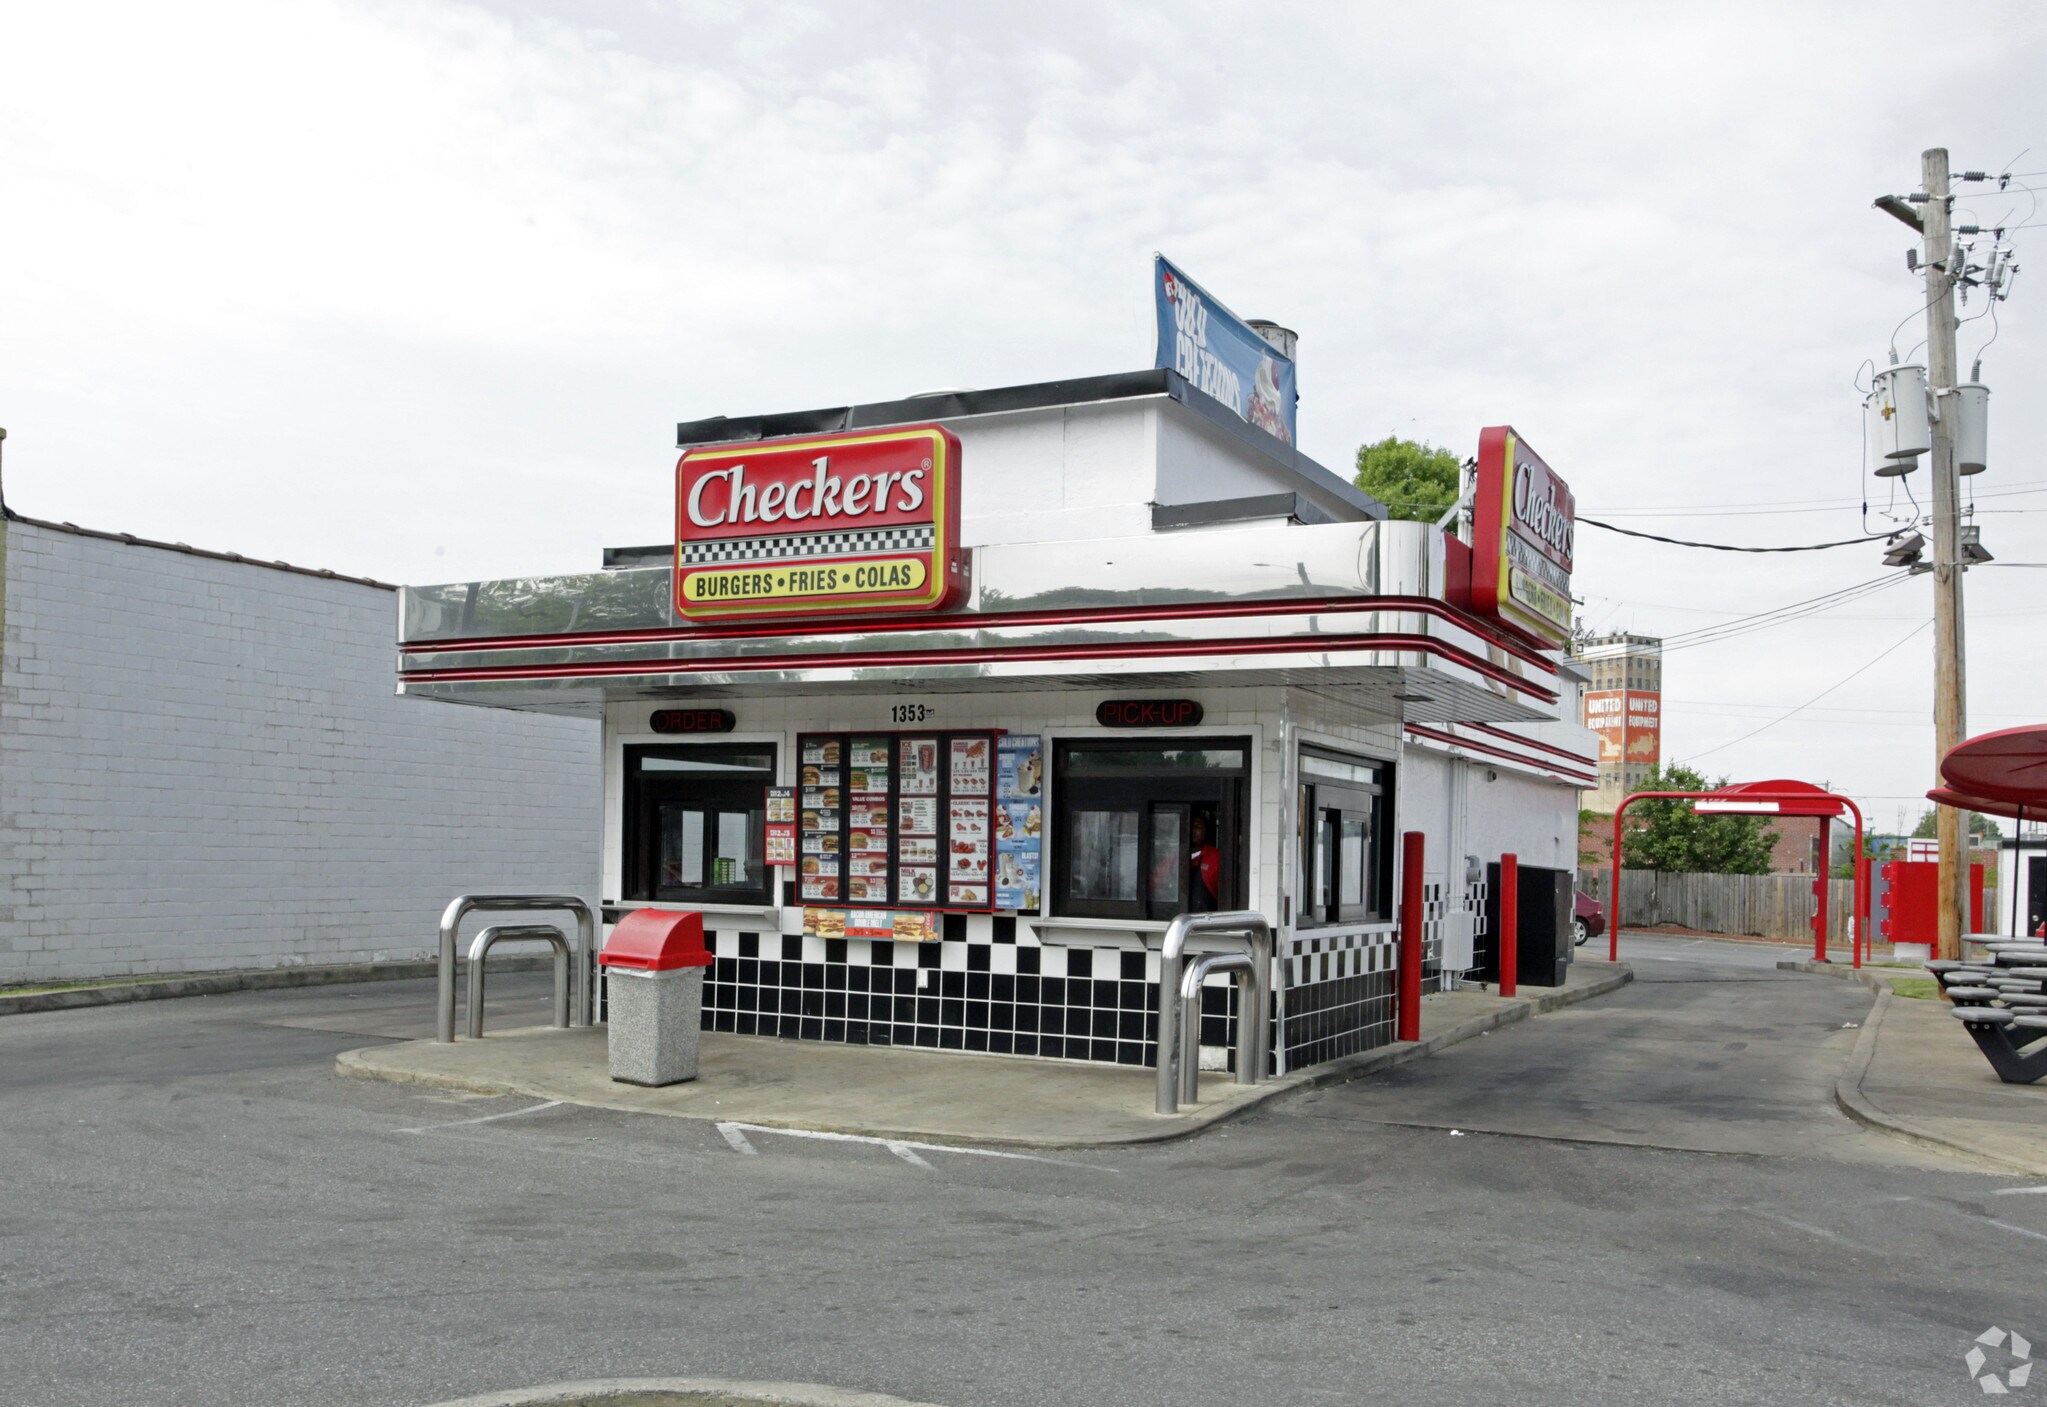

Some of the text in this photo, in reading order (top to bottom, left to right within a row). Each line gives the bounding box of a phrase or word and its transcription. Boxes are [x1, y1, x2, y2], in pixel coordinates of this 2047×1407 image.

[687, 456, 925, 527] Checkers
[1513, 462, 1574, 562] Checkers
[696, 564, 911, 597] BURGERS FRIES COLAS
[891, 704, 925, 723] 1353
[1104, 702, 1193, 724] PICK-UP
[1588, 697, 1621, 714] UNITED
[1629, 697, 1658, 713] UNITED
[656, 711, 722, 730] ORDER
[1588, 715, 1622, 730] EQUIPMENT
[1628, 714, 1658, 729] EQUIPMENT
